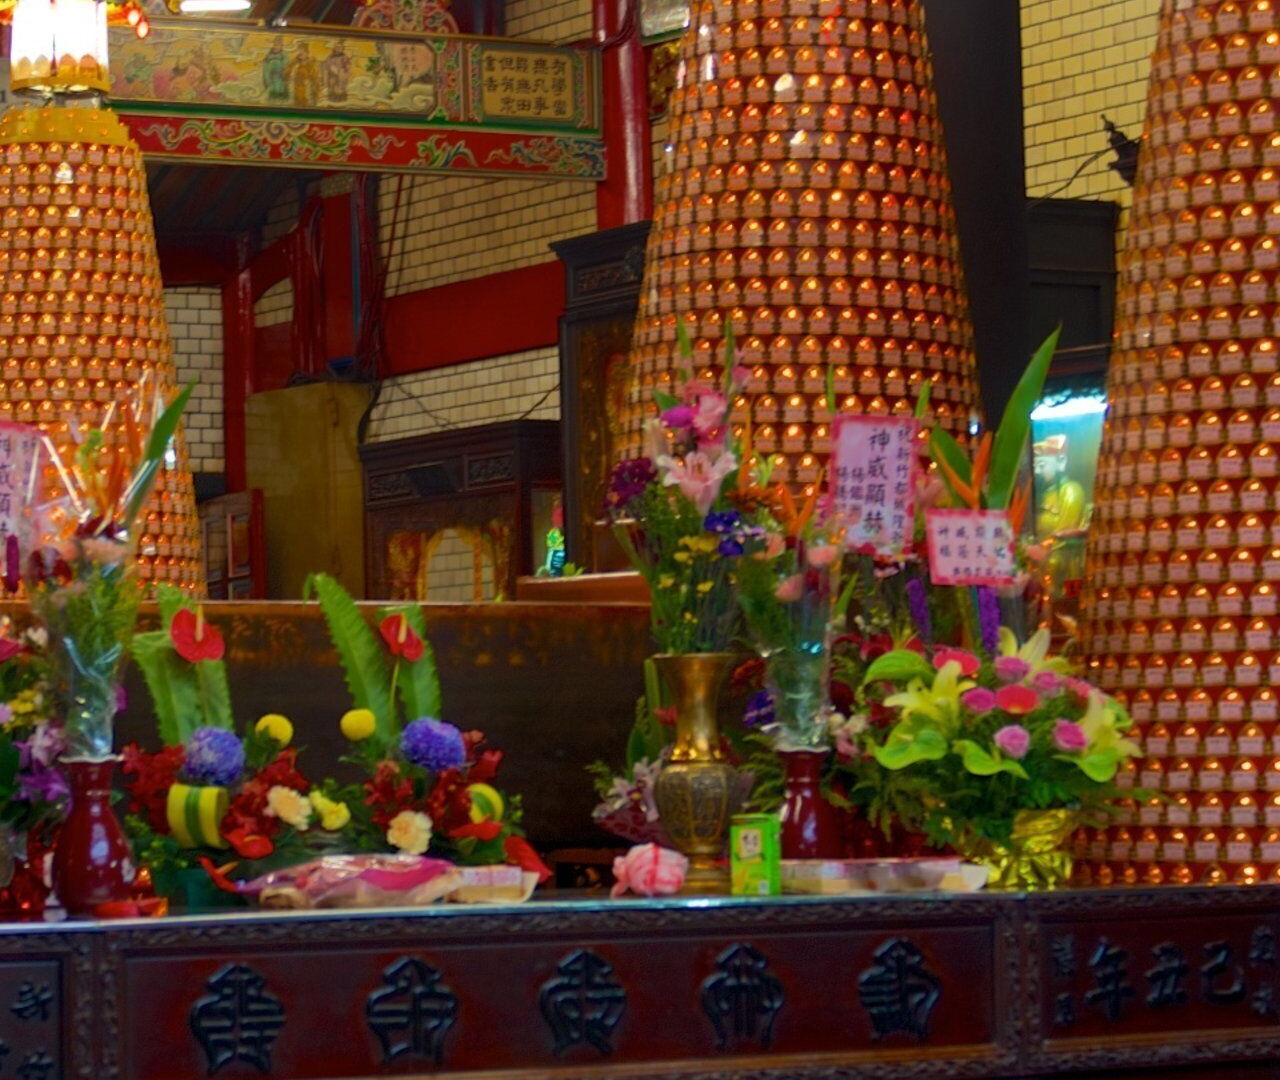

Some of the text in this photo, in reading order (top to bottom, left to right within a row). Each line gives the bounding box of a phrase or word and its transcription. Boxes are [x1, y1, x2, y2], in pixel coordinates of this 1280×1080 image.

[863, 428, 890, 534] 神威顯赫
[1085, 935, 1246, 1022] 己丑年
